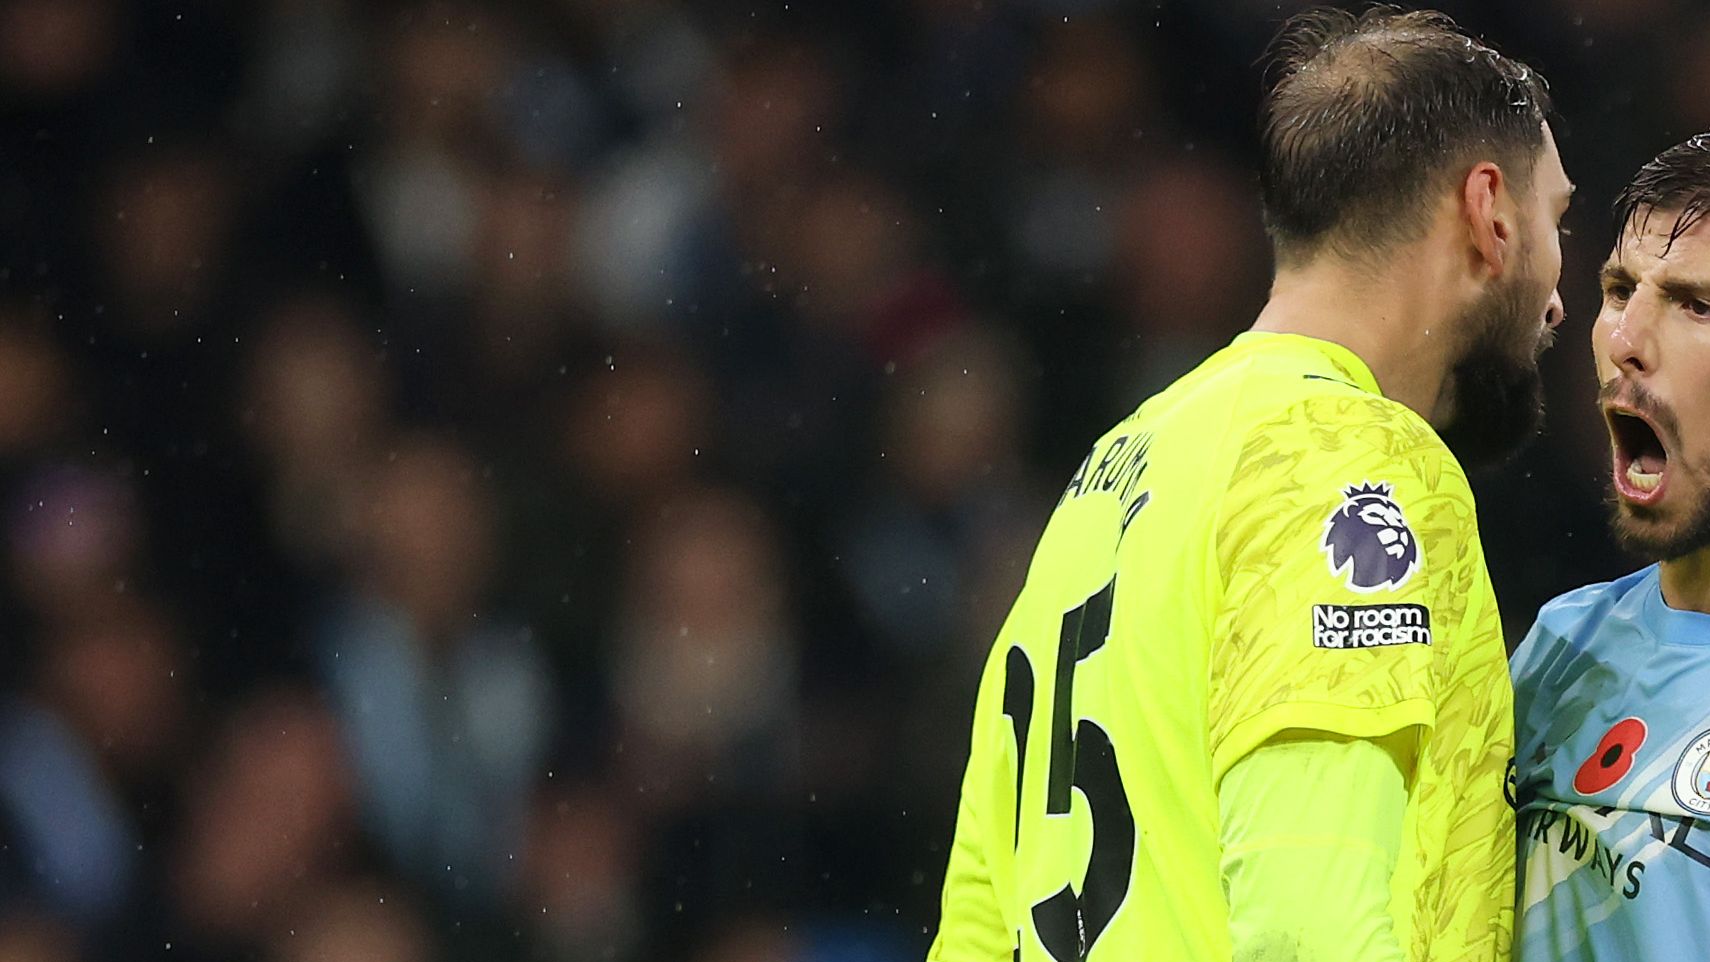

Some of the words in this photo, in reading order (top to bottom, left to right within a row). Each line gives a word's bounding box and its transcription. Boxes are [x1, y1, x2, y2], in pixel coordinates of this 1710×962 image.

[1313, 604, 1350, 629] No
[1353, 607, 1422, 628] room
[1314, 624, 1349, 649] for
[1352, 624, 1432, 648] racism
[1528, 808, 1646, 900] IRWAYS
